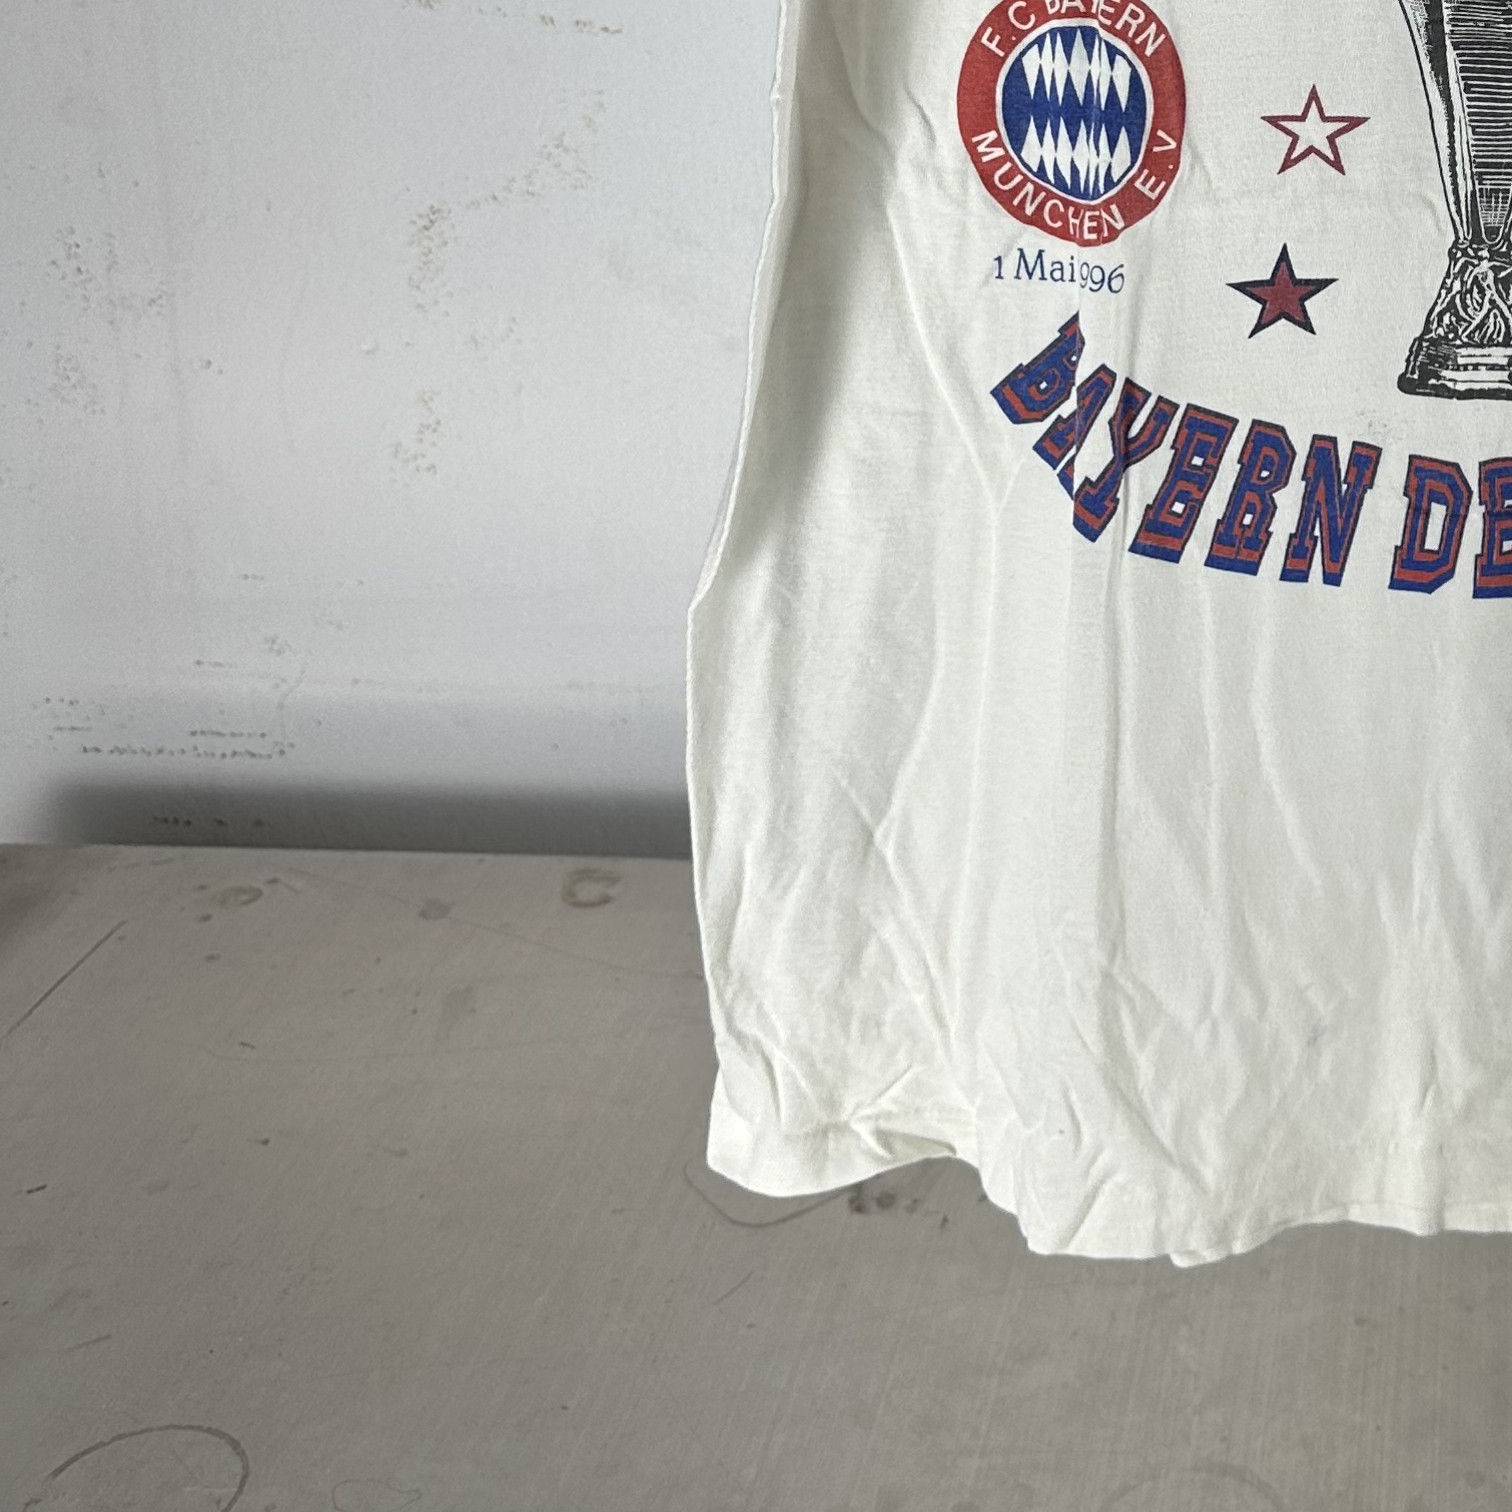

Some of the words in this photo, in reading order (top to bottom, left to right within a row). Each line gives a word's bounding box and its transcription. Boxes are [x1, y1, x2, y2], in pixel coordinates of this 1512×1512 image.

[993, 255, 1005, 280] 1
[1013, 247, 1077, 283] Mai
[1079, 261, 1125, 294] 996
[990, 310, 1383, 586] BAYERN
